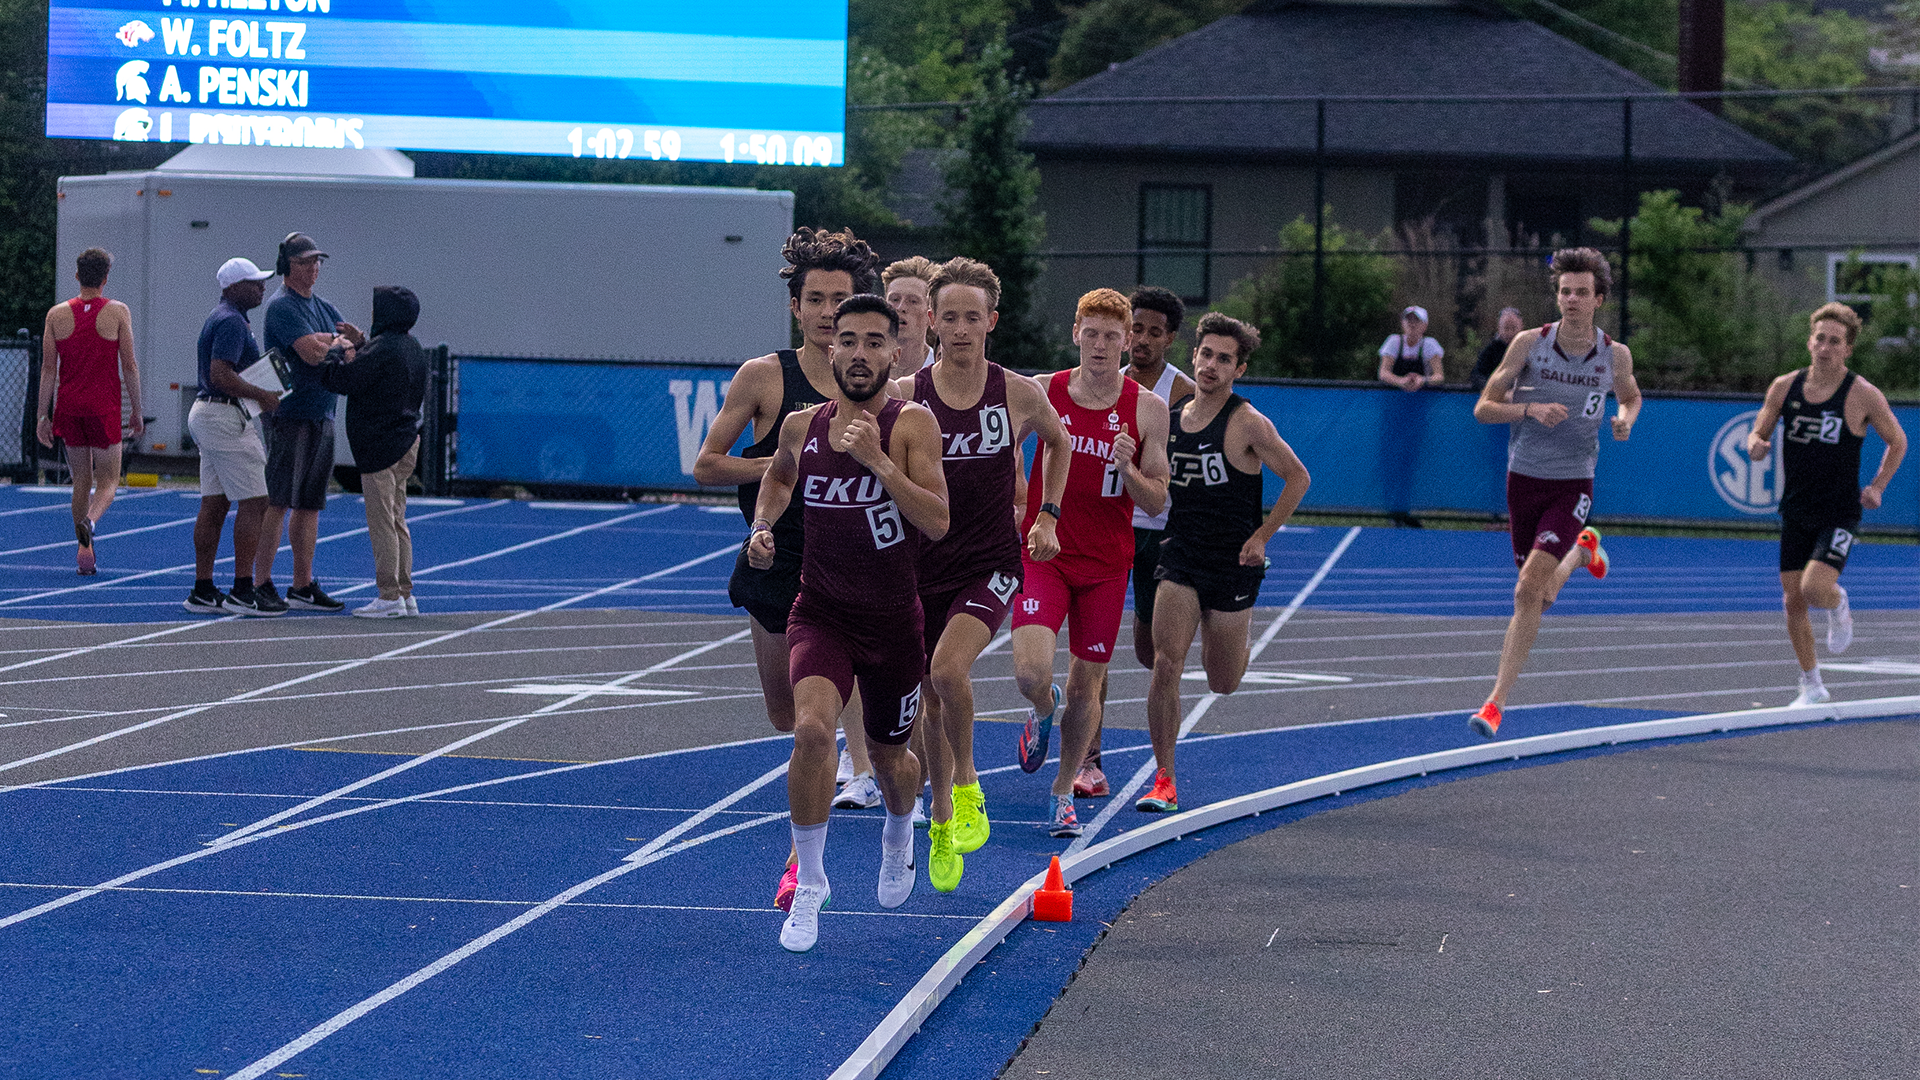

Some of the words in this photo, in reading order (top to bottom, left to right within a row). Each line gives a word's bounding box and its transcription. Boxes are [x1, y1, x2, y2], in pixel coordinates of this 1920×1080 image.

[161, 17, 201, 56] W.
[208, 19, 307, 60] FOLTZ
[159, 64, 191, 104] A.
[199, 66, 309, 107] PENSKI
[1540, 368, 1601, 388] SALUKIS
[1585, 394, 1601, 416] 3
[986, 410, 1004, 446] 9
[1822, 418, 1838, 441] 2
[1107, 467, 1119, 495] 1
[1206, 455, 1222, 483] 6
[803, 475, 884, 503] EKU
[1577, 497, 1589, 519] 3
[871, 504, 899, 545] 5
[1832, 531, 1850, 550] 2
[902, 693, 919, 723] 5
